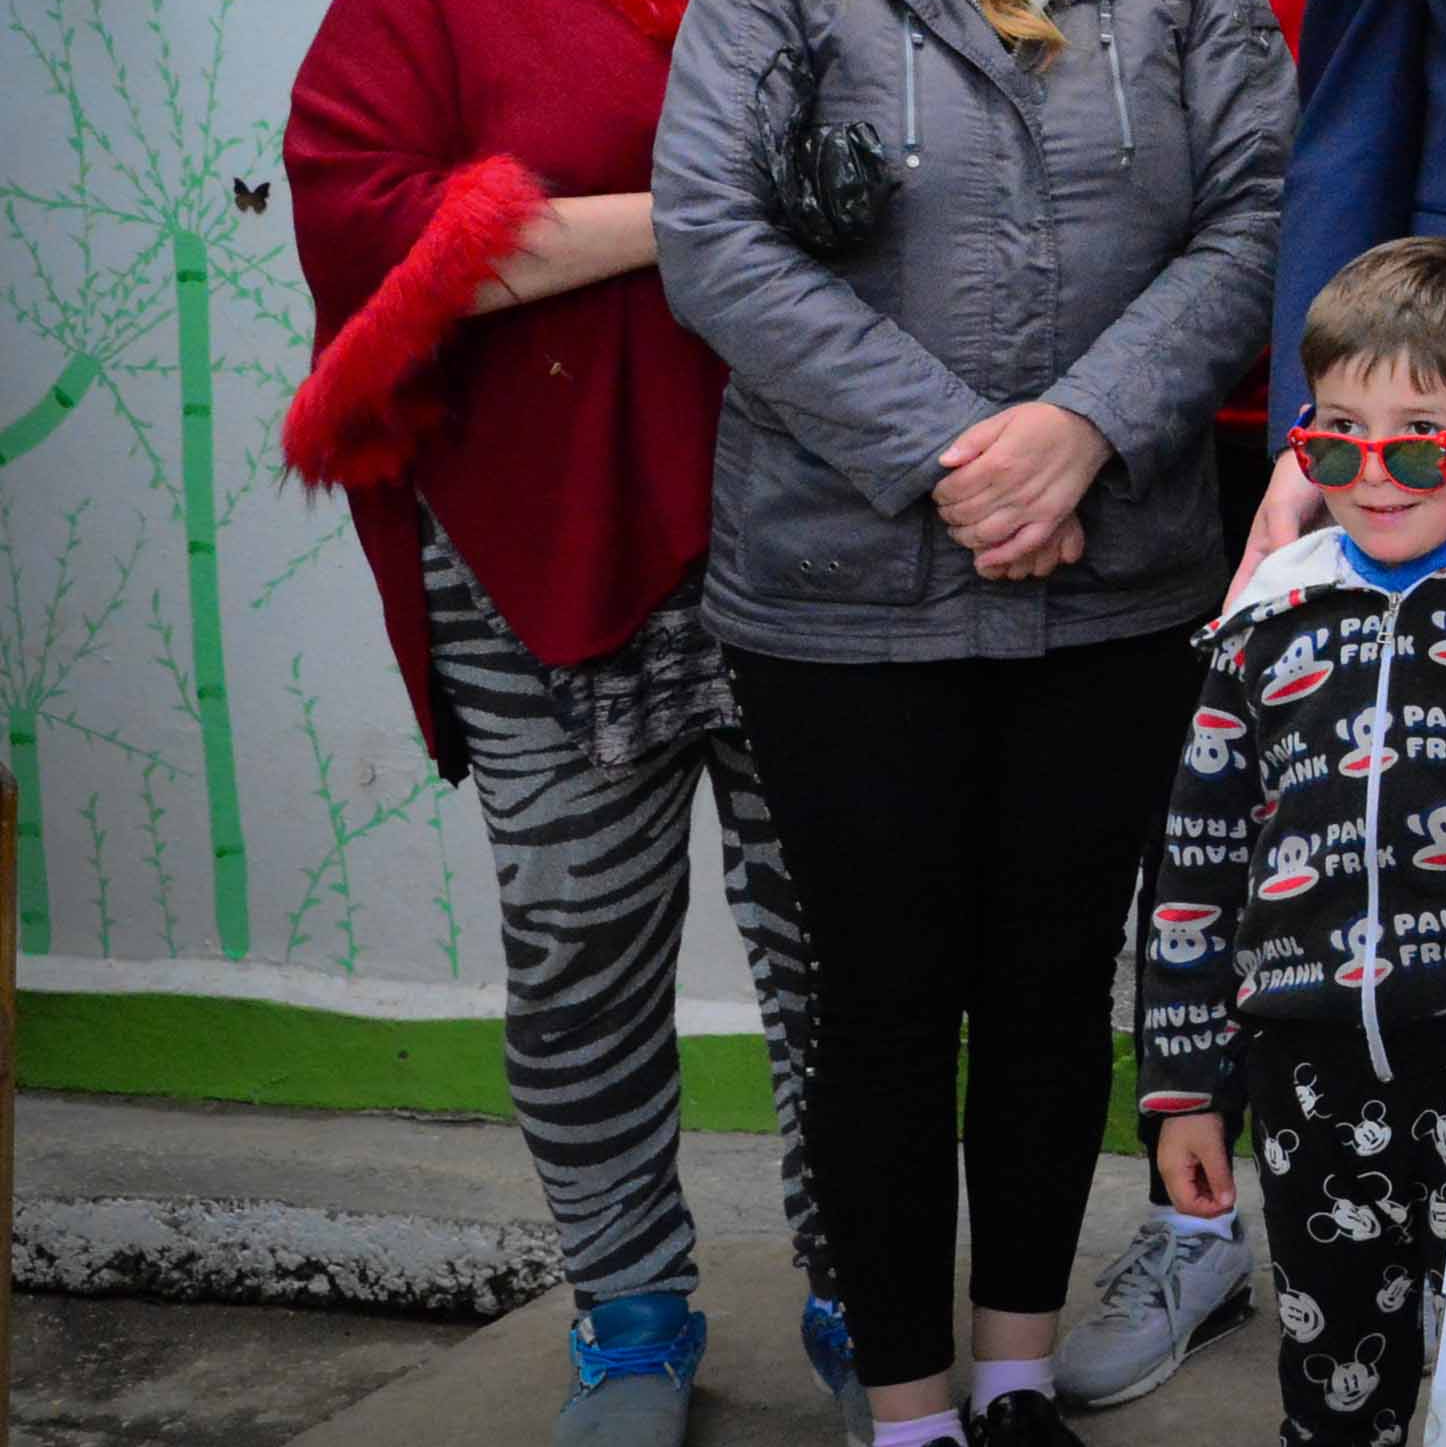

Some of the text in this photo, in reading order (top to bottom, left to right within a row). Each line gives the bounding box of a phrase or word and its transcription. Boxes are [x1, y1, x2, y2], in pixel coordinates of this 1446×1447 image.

[1340, 634, 1416, 665] FRK
[1165, 816, 1248, 840] FRAN
[1167, 844, 1249, 867] PAUL
[1324, 845, 1397, 878] FRK
[1258, 961, 1326, 996] FRANK
